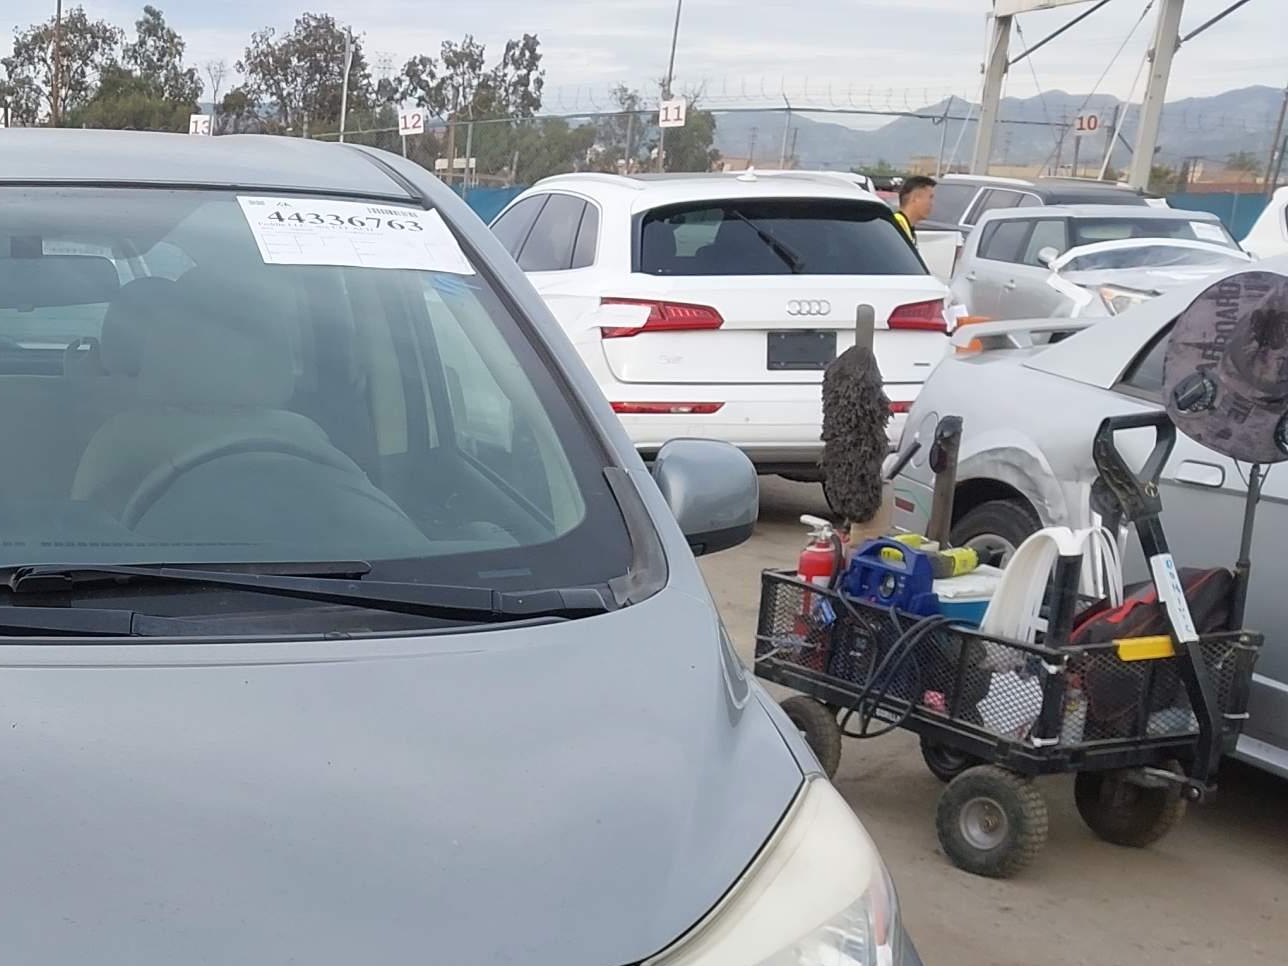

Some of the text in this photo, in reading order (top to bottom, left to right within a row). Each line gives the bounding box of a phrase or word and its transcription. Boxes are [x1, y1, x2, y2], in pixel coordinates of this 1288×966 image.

[400, 113, 422, 130] 12
[662, 106, 683, 122] 11
[1077, 114, 1097, 131] 10
[191, 119, 210, 135] 13
[267, 210, 423, 232] 44336763
